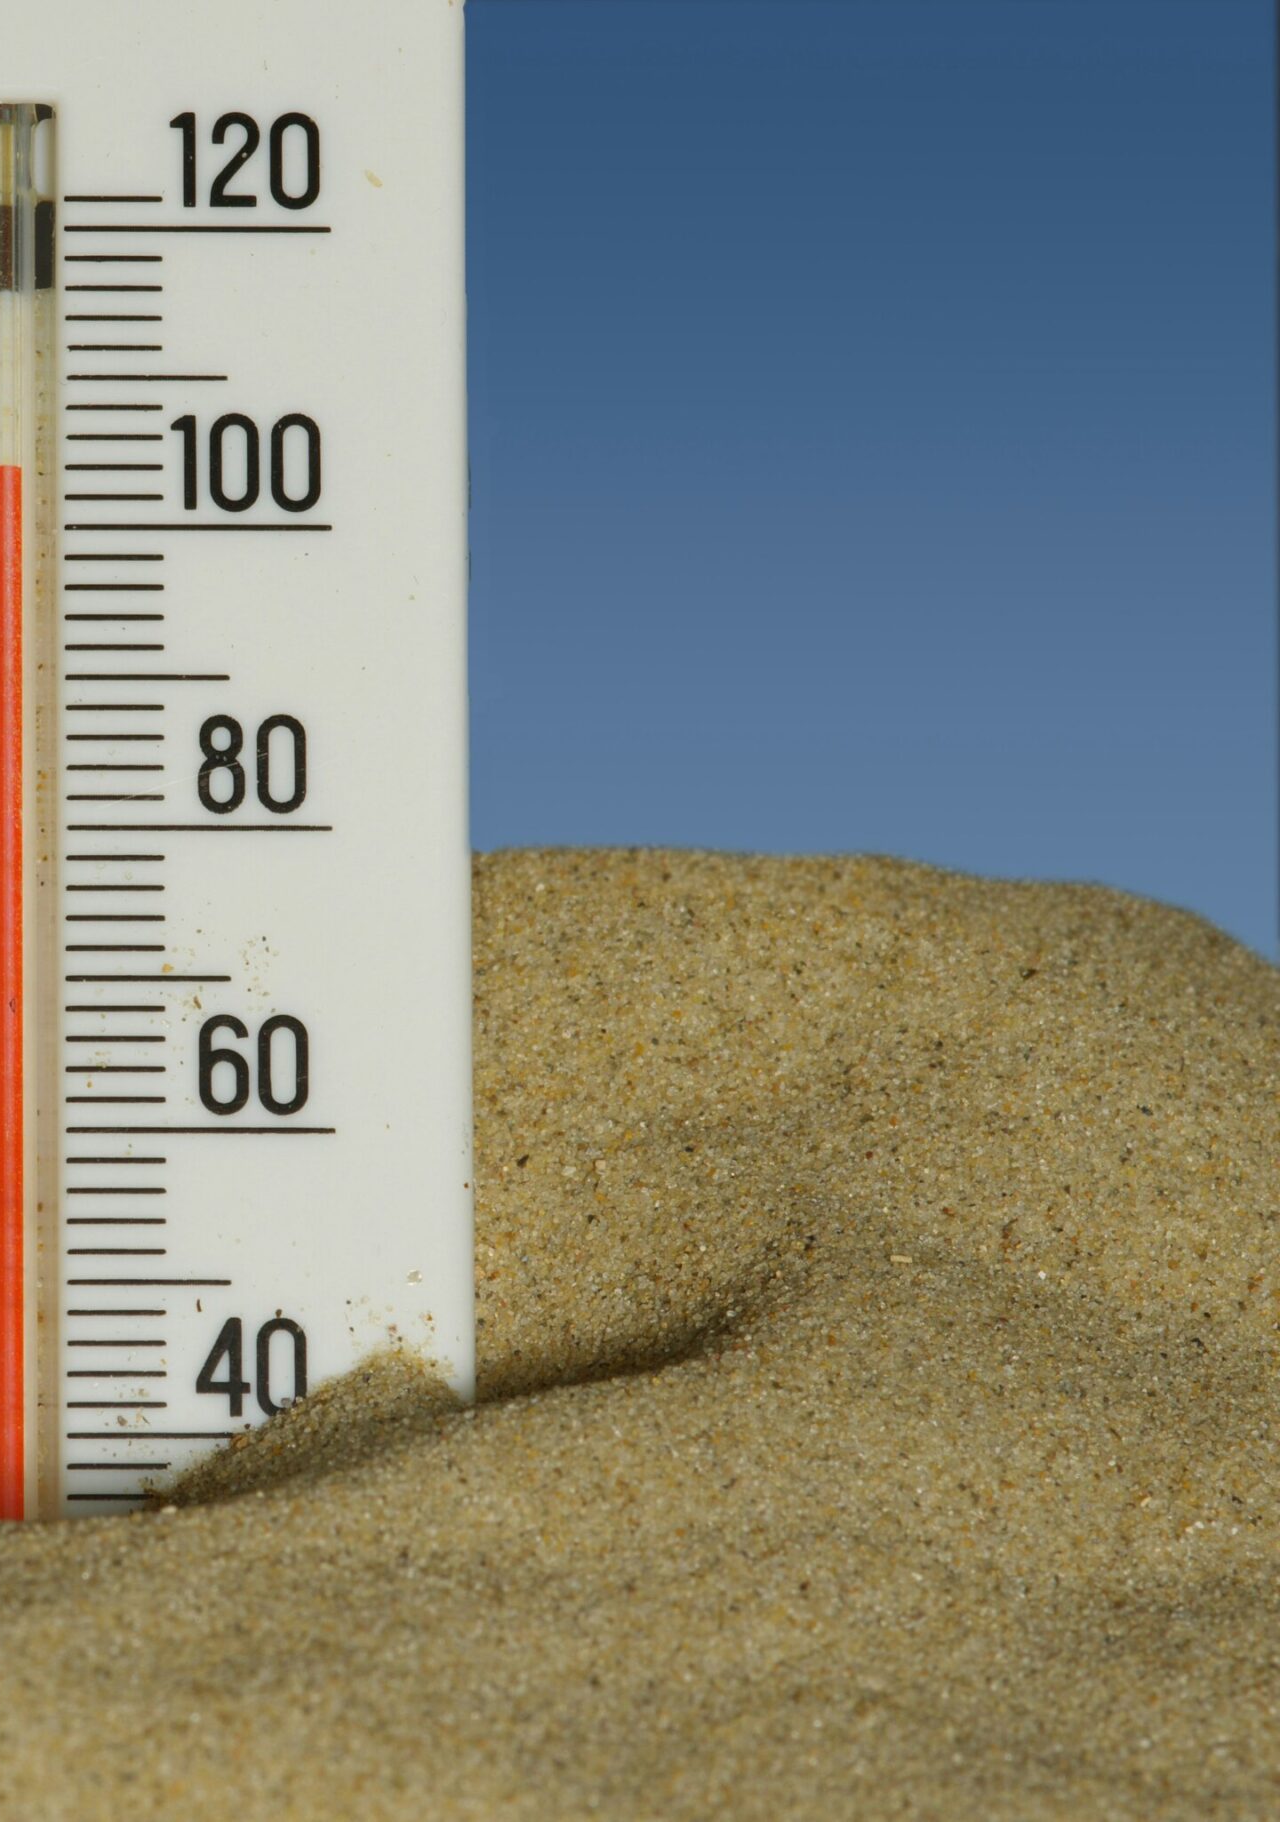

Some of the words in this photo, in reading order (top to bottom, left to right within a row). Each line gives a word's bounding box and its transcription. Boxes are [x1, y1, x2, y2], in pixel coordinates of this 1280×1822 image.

[169, 111, 321, 210] 120
[170, 412, 322, 513] 100
[197, 714, 307, 815] 80
[198, 1014, 309, 1116] 60
[195, 1317, 308, 1417] 40
